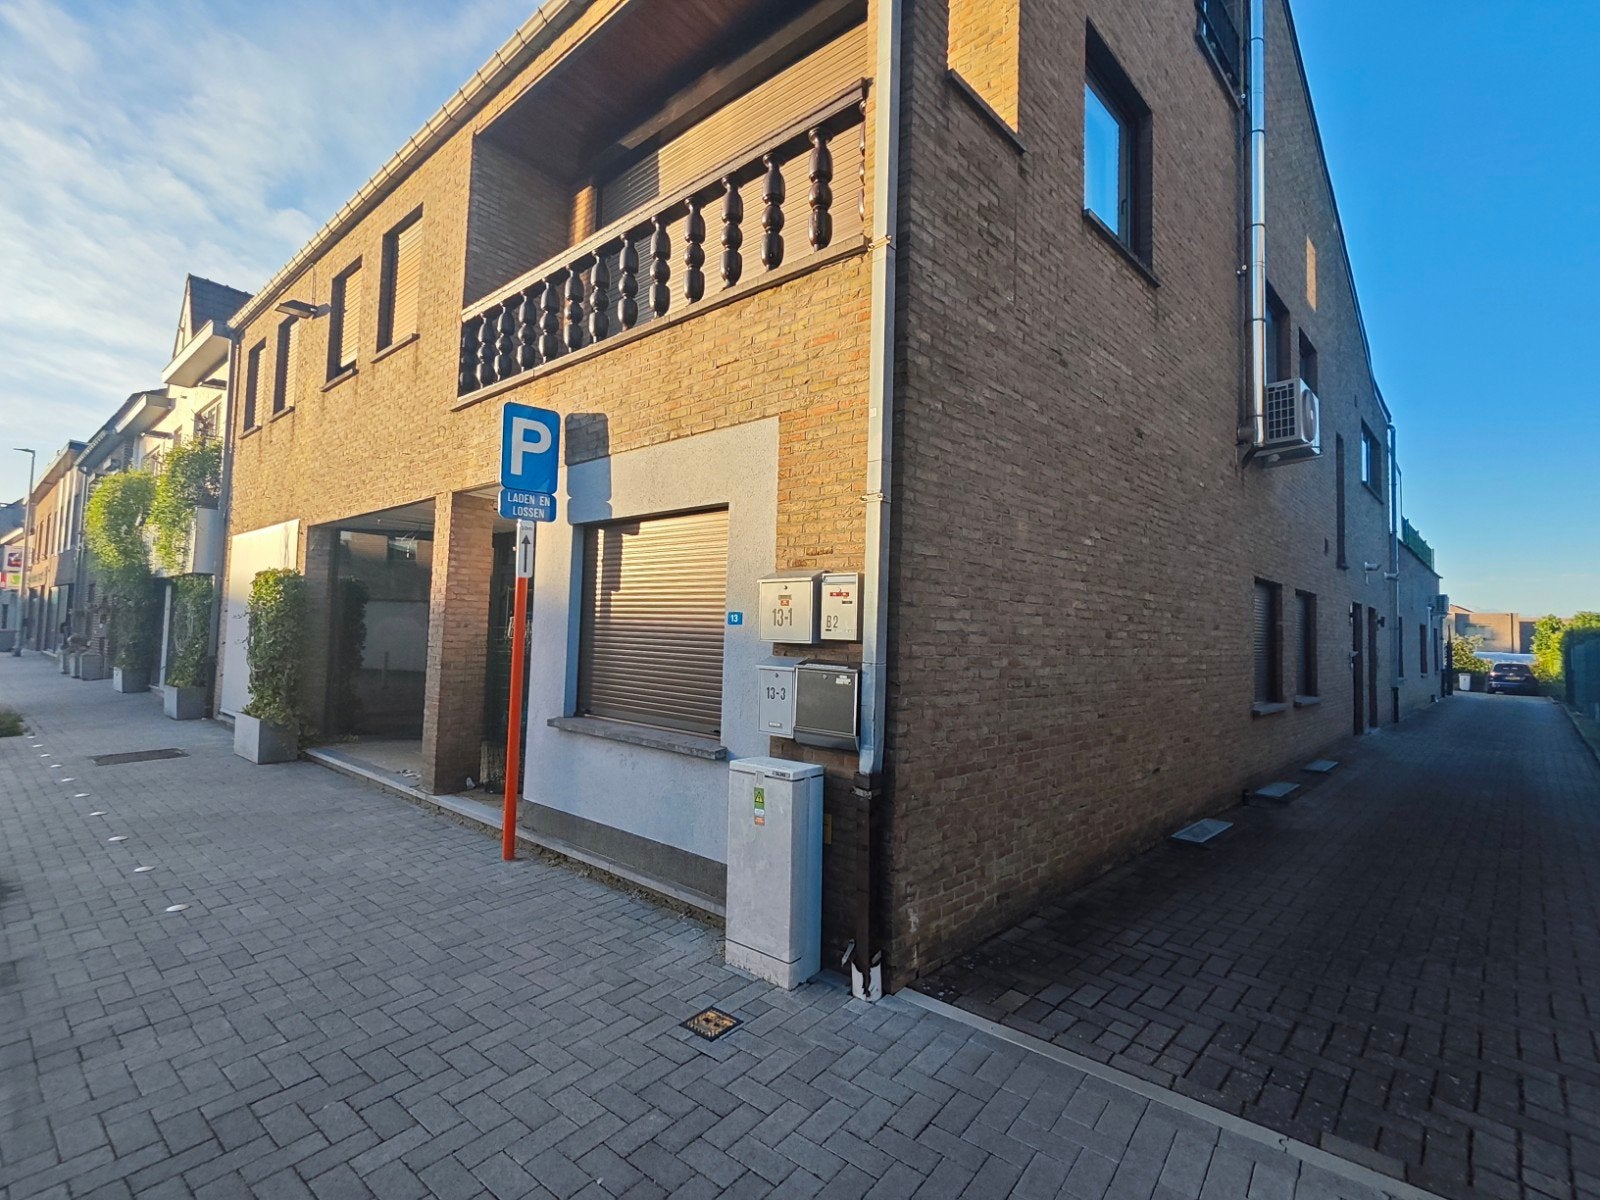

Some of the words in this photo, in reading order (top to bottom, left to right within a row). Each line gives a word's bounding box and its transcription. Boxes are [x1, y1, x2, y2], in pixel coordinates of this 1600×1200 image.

[510, 416, 552, 476] P
[507, 492, 535, 504] LADEN
[539, 496, 551, 507] EN
[512, 506, 545, 518] LOSSEN
[731, 614, 738, 623] 13
[772, 607, 793, 626] 13-1
[766, 686, 786, 700] 13-3
